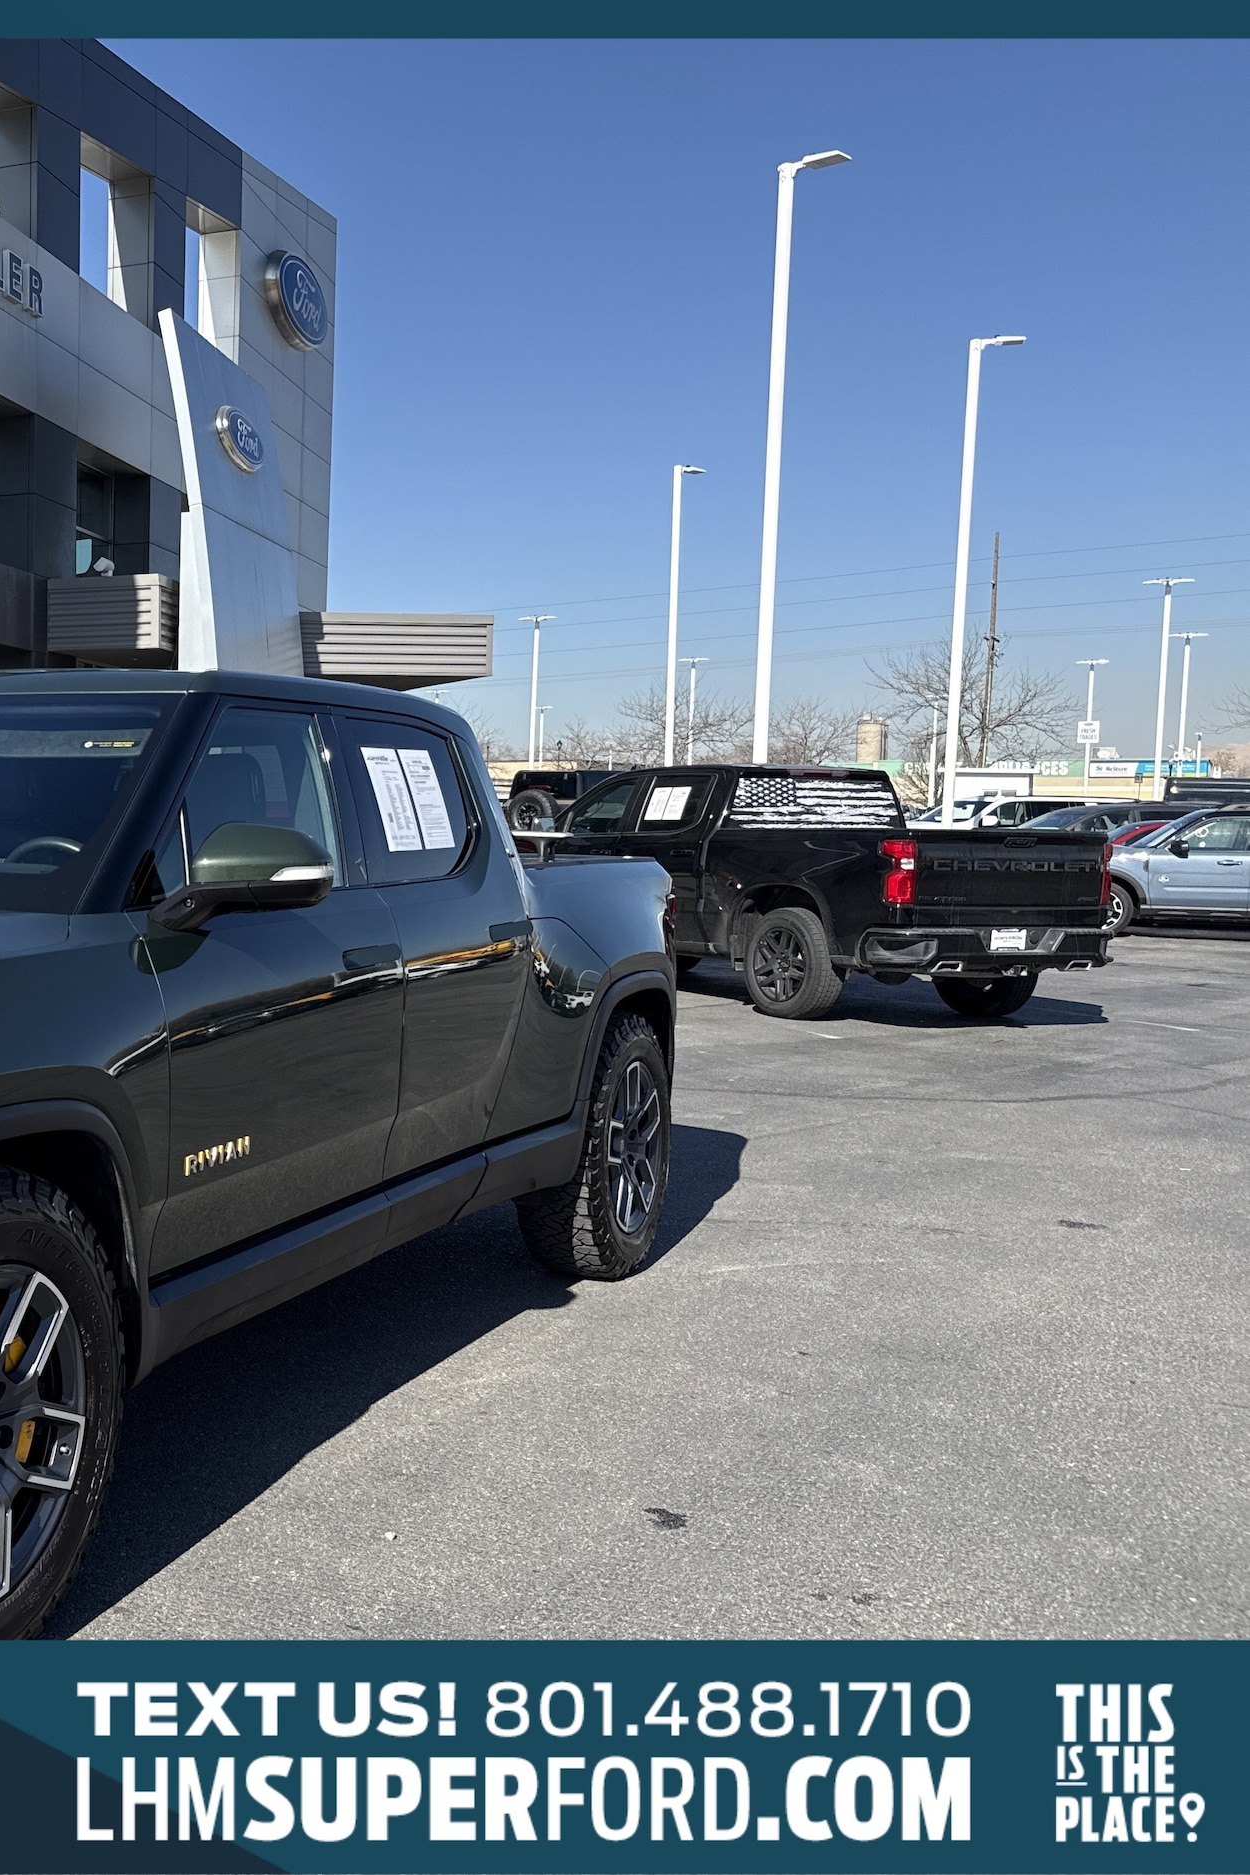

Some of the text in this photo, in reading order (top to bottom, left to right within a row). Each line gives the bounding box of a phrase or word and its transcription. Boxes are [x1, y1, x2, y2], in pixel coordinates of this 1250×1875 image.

[291, 269, 322, 332] Ford
[237, 417, 259, 458] Ford
[934, 859, 1097, 873] CHEVROLET
[183, 1135, 250, 1177] RIVIAN
